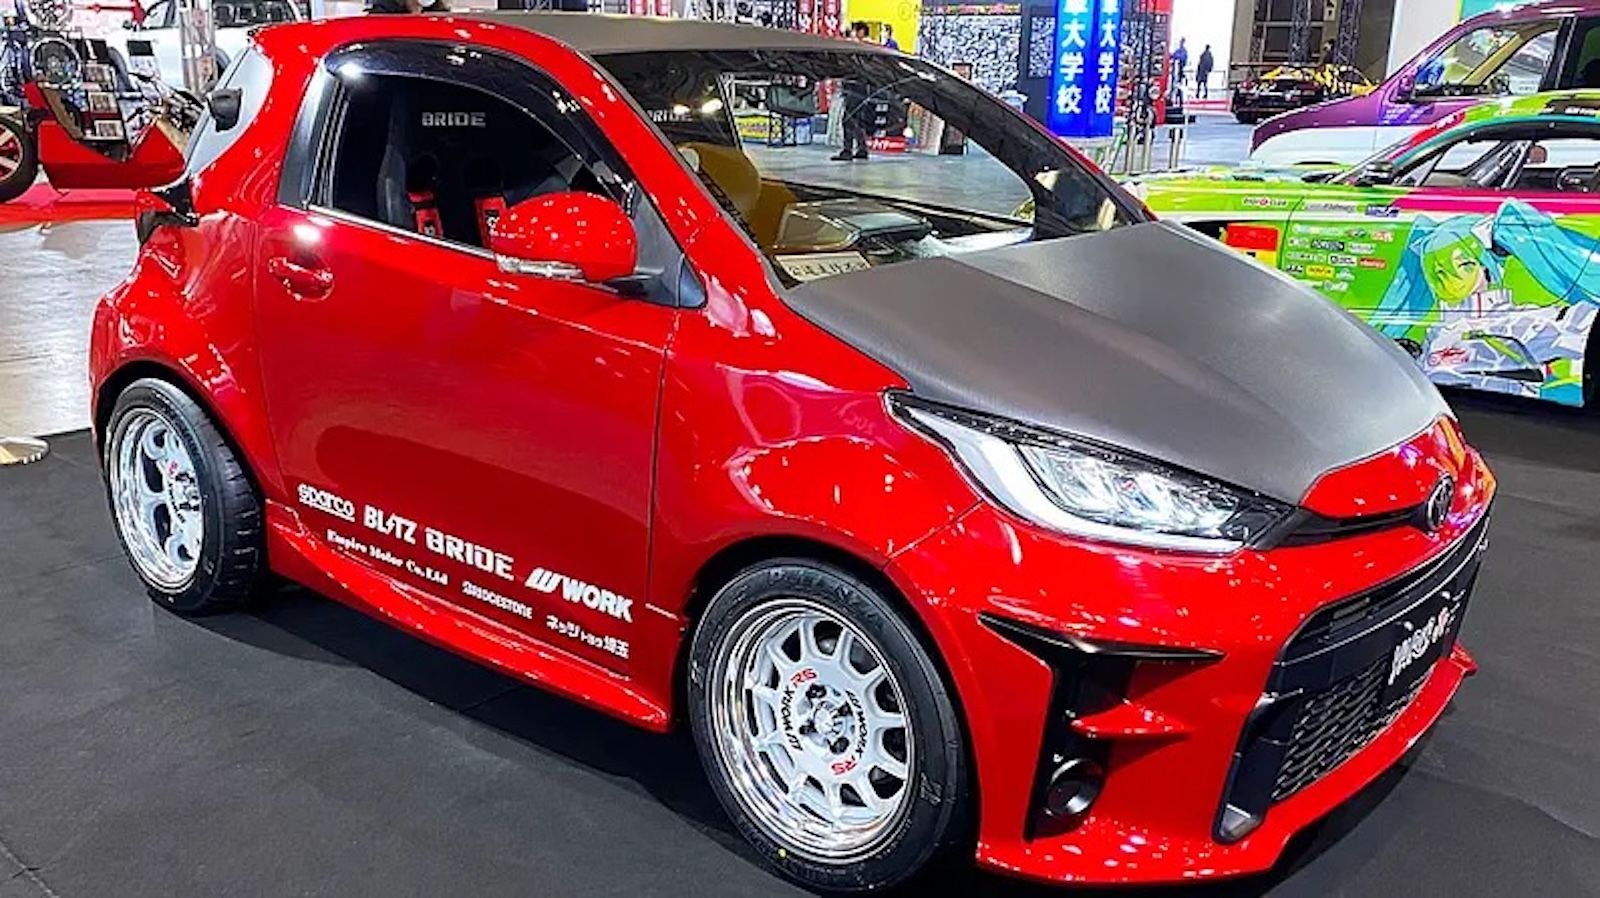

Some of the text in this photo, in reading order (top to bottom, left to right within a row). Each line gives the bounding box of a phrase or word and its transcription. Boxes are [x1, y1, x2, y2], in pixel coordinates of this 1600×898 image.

[421, 111, 487, 128] BRIDE
[297, 483, 356, 523] sparco
[363, 504, 418, 545] BLITZ
[424, 526, 515, 581] BRIDE
[461, 580, 533, 620] BRIDGESTONE
[562, 576, 634, 624] WORK
[790, 667, 818, 689] RS
[831, 754, 859, 776] RS
